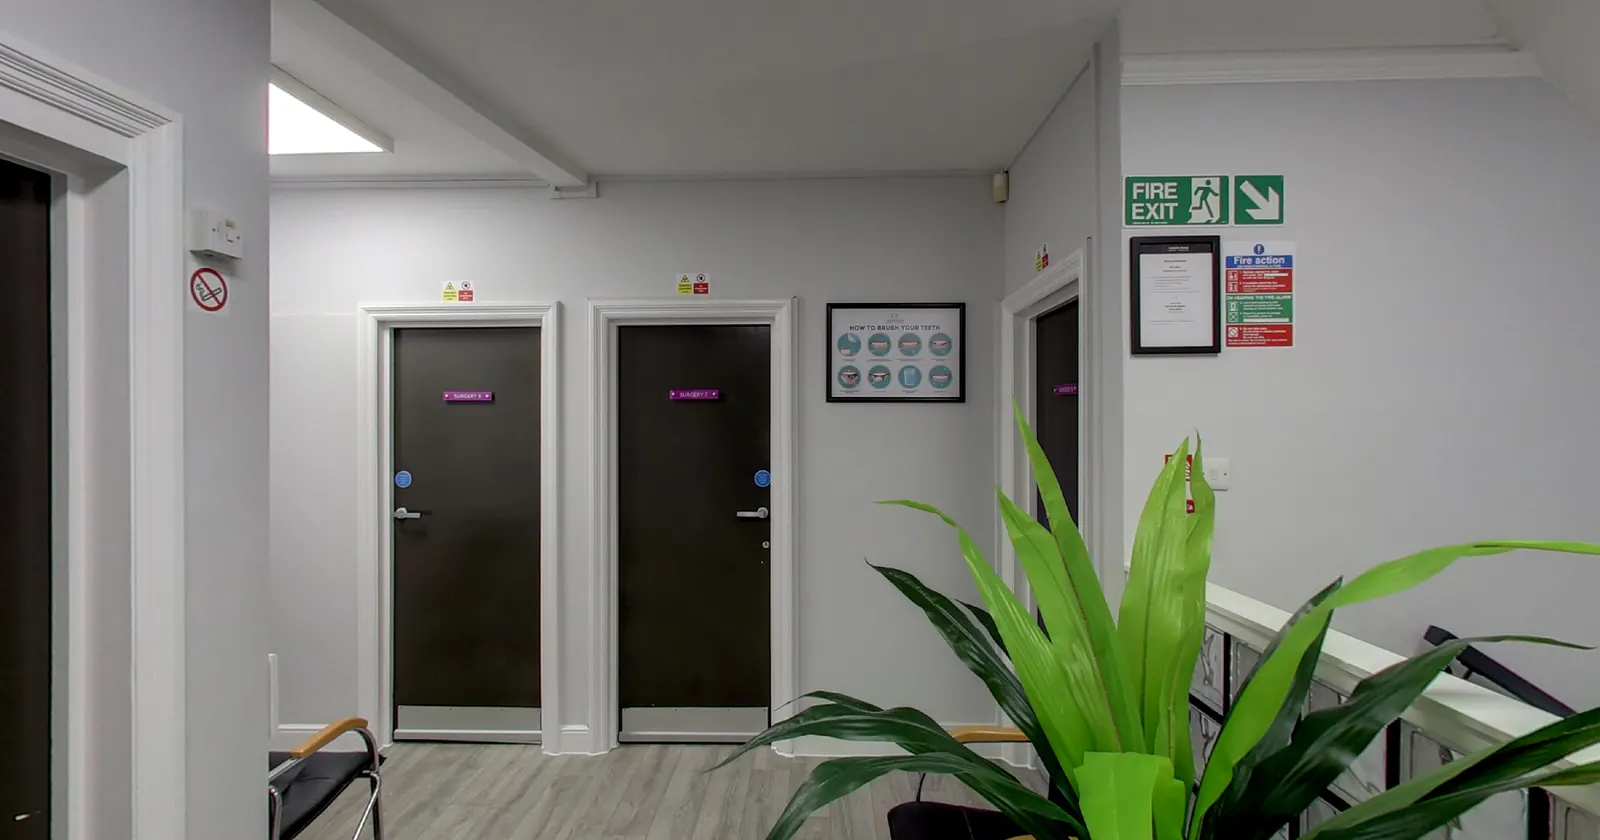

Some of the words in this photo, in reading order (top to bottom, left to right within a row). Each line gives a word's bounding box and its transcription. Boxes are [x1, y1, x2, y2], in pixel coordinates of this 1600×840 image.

[1132, 182, 1178, 200] FIRE
[1132, 203, 1178, 220] EXIT
[1233, 256, 1253, 265] Fire
[1255, 256, 1285, 265] action
